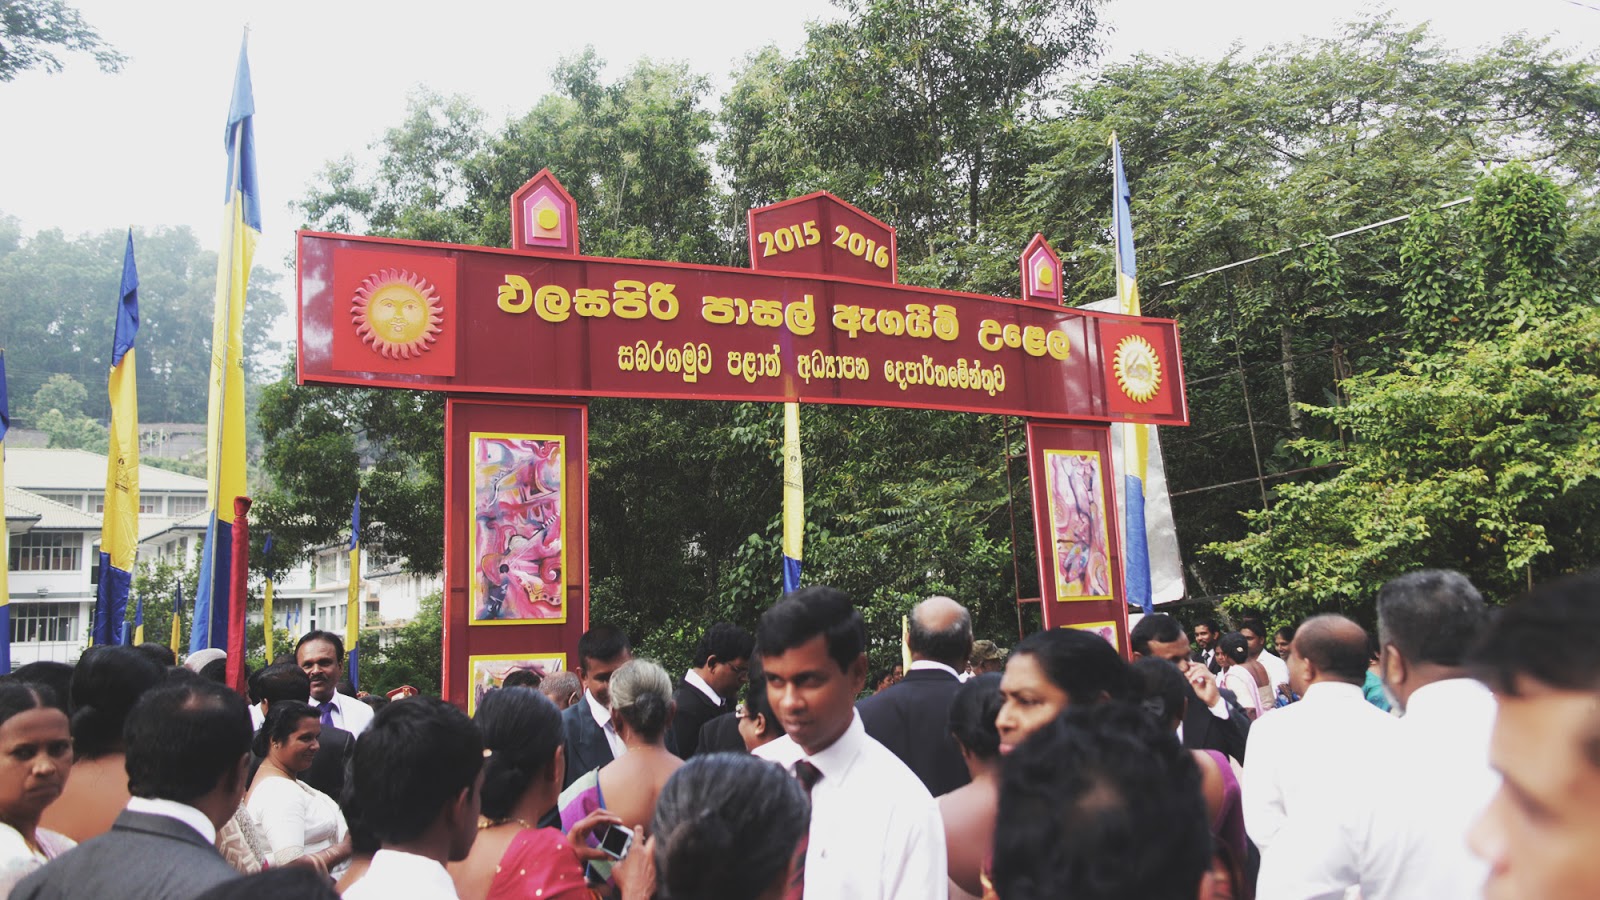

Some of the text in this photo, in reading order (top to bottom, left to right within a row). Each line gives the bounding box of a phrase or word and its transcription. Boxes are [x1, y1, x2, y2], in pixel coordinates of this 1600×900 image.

[758, 220, 889, 268] 2015 2016
[702, 294, 816, 335] පාසල්
[833, 303, 960, 341] ඇගයීම්
[977, 319, 1071, 360] උළෙල
[618, 340, 1006, 397] සබරගමුව පළාත් අධ්‍යාපන දෙපාර්තමේන්තුව
